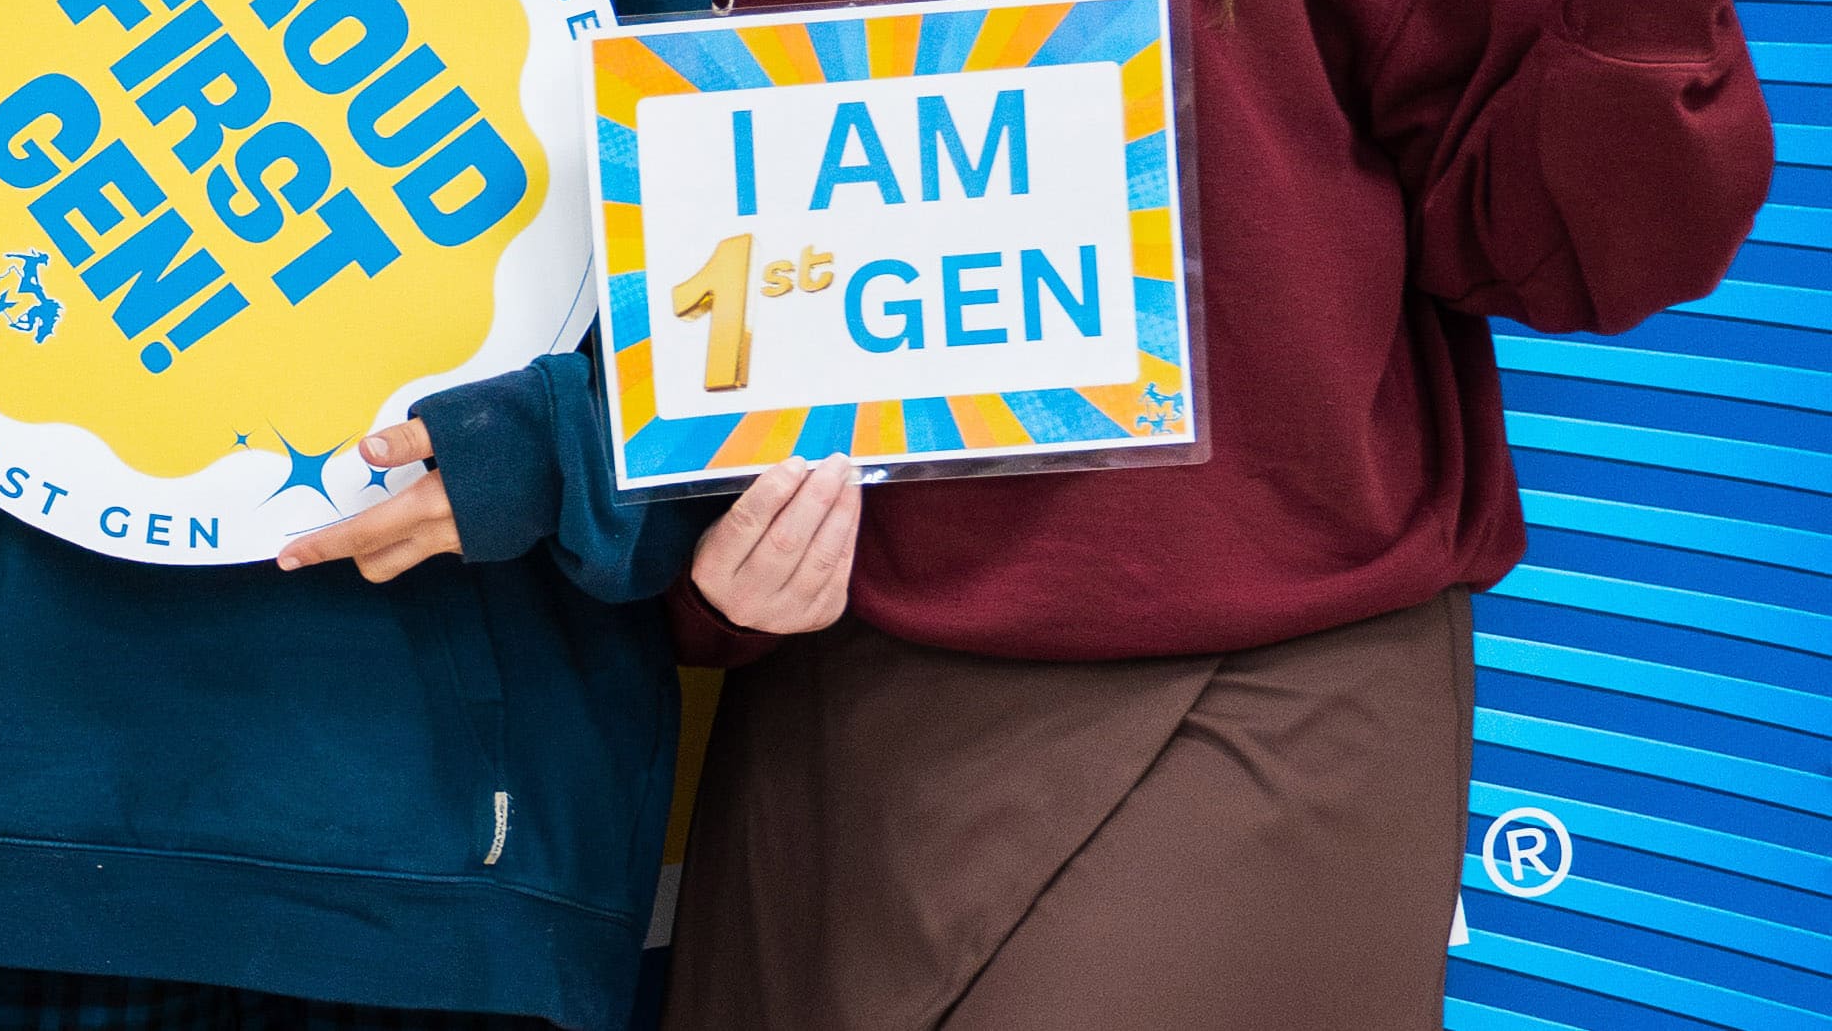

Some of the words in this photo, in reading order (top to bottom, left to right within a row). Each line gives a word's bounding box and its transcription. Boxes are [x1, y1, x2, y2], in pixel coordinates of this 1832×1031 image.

[732, 109, 758, 216] I
[809, 88, 1029, 211] AM
[672, 233, 836, 392] 1st
[844, 244, 1102, 354] GEN
[99, 506, 219, 549] GEN
